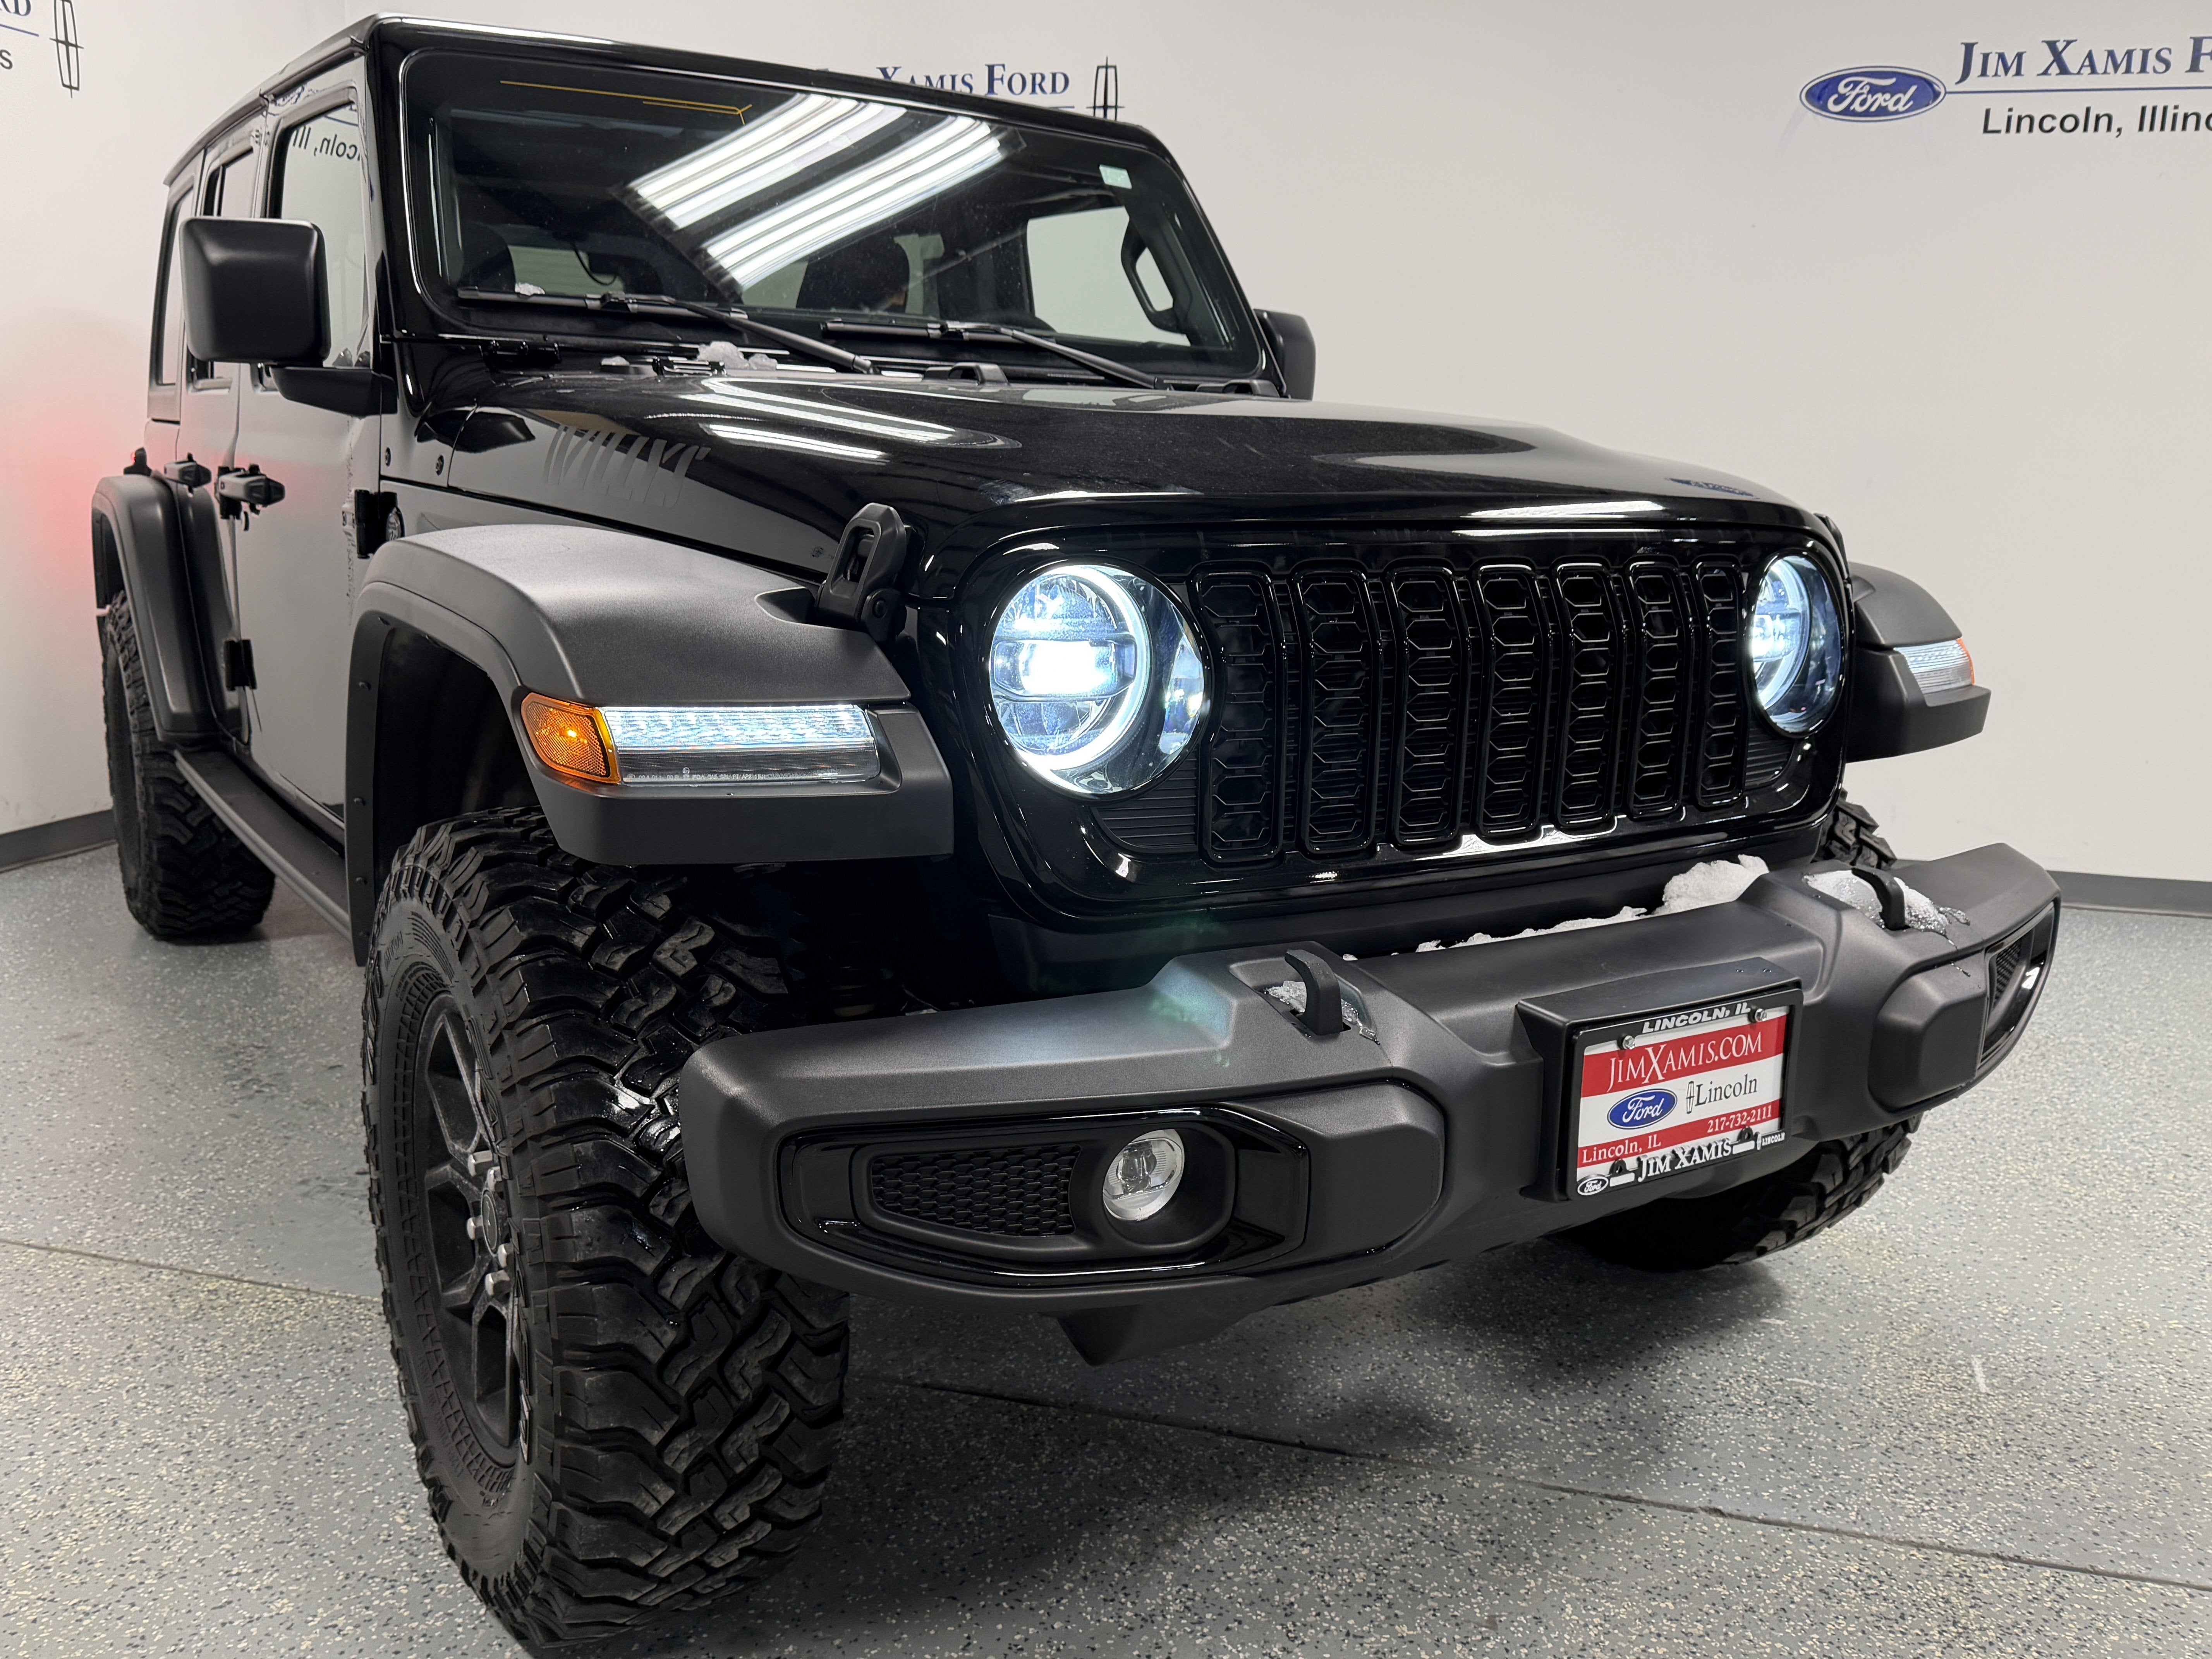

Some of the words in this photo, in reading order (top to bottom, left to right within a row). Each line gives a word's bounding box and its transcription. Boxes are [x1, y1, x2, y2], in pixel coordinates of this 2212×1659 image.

[0, 0, 31, 16] D
[1827, 77, 1918, 112] Ford
[1983, 107, 2122, 138] Lincoln,
[1642, 1007, 1730, 1033] LINCOLN,
[1735, 1002, 1751, 1015] IL
[1695, 1073, 1757, 1106] Lincoln
[1622, 1095, 1664, 1123] Ford
[1707, 1105, 1771, 1133] 217-732-2111
[1582, 1140, 1642, 1163] Lincoln,
[1647, 1134, 1661, 1149] IL
[1762, 1132, 1785, 1146] LINCOLN
[1638, 1155, 1671, 1182] JIM
[1674, 1140, 1731, 1170] XAMIS
[1584, 1180, 1602, 1193] Ford
